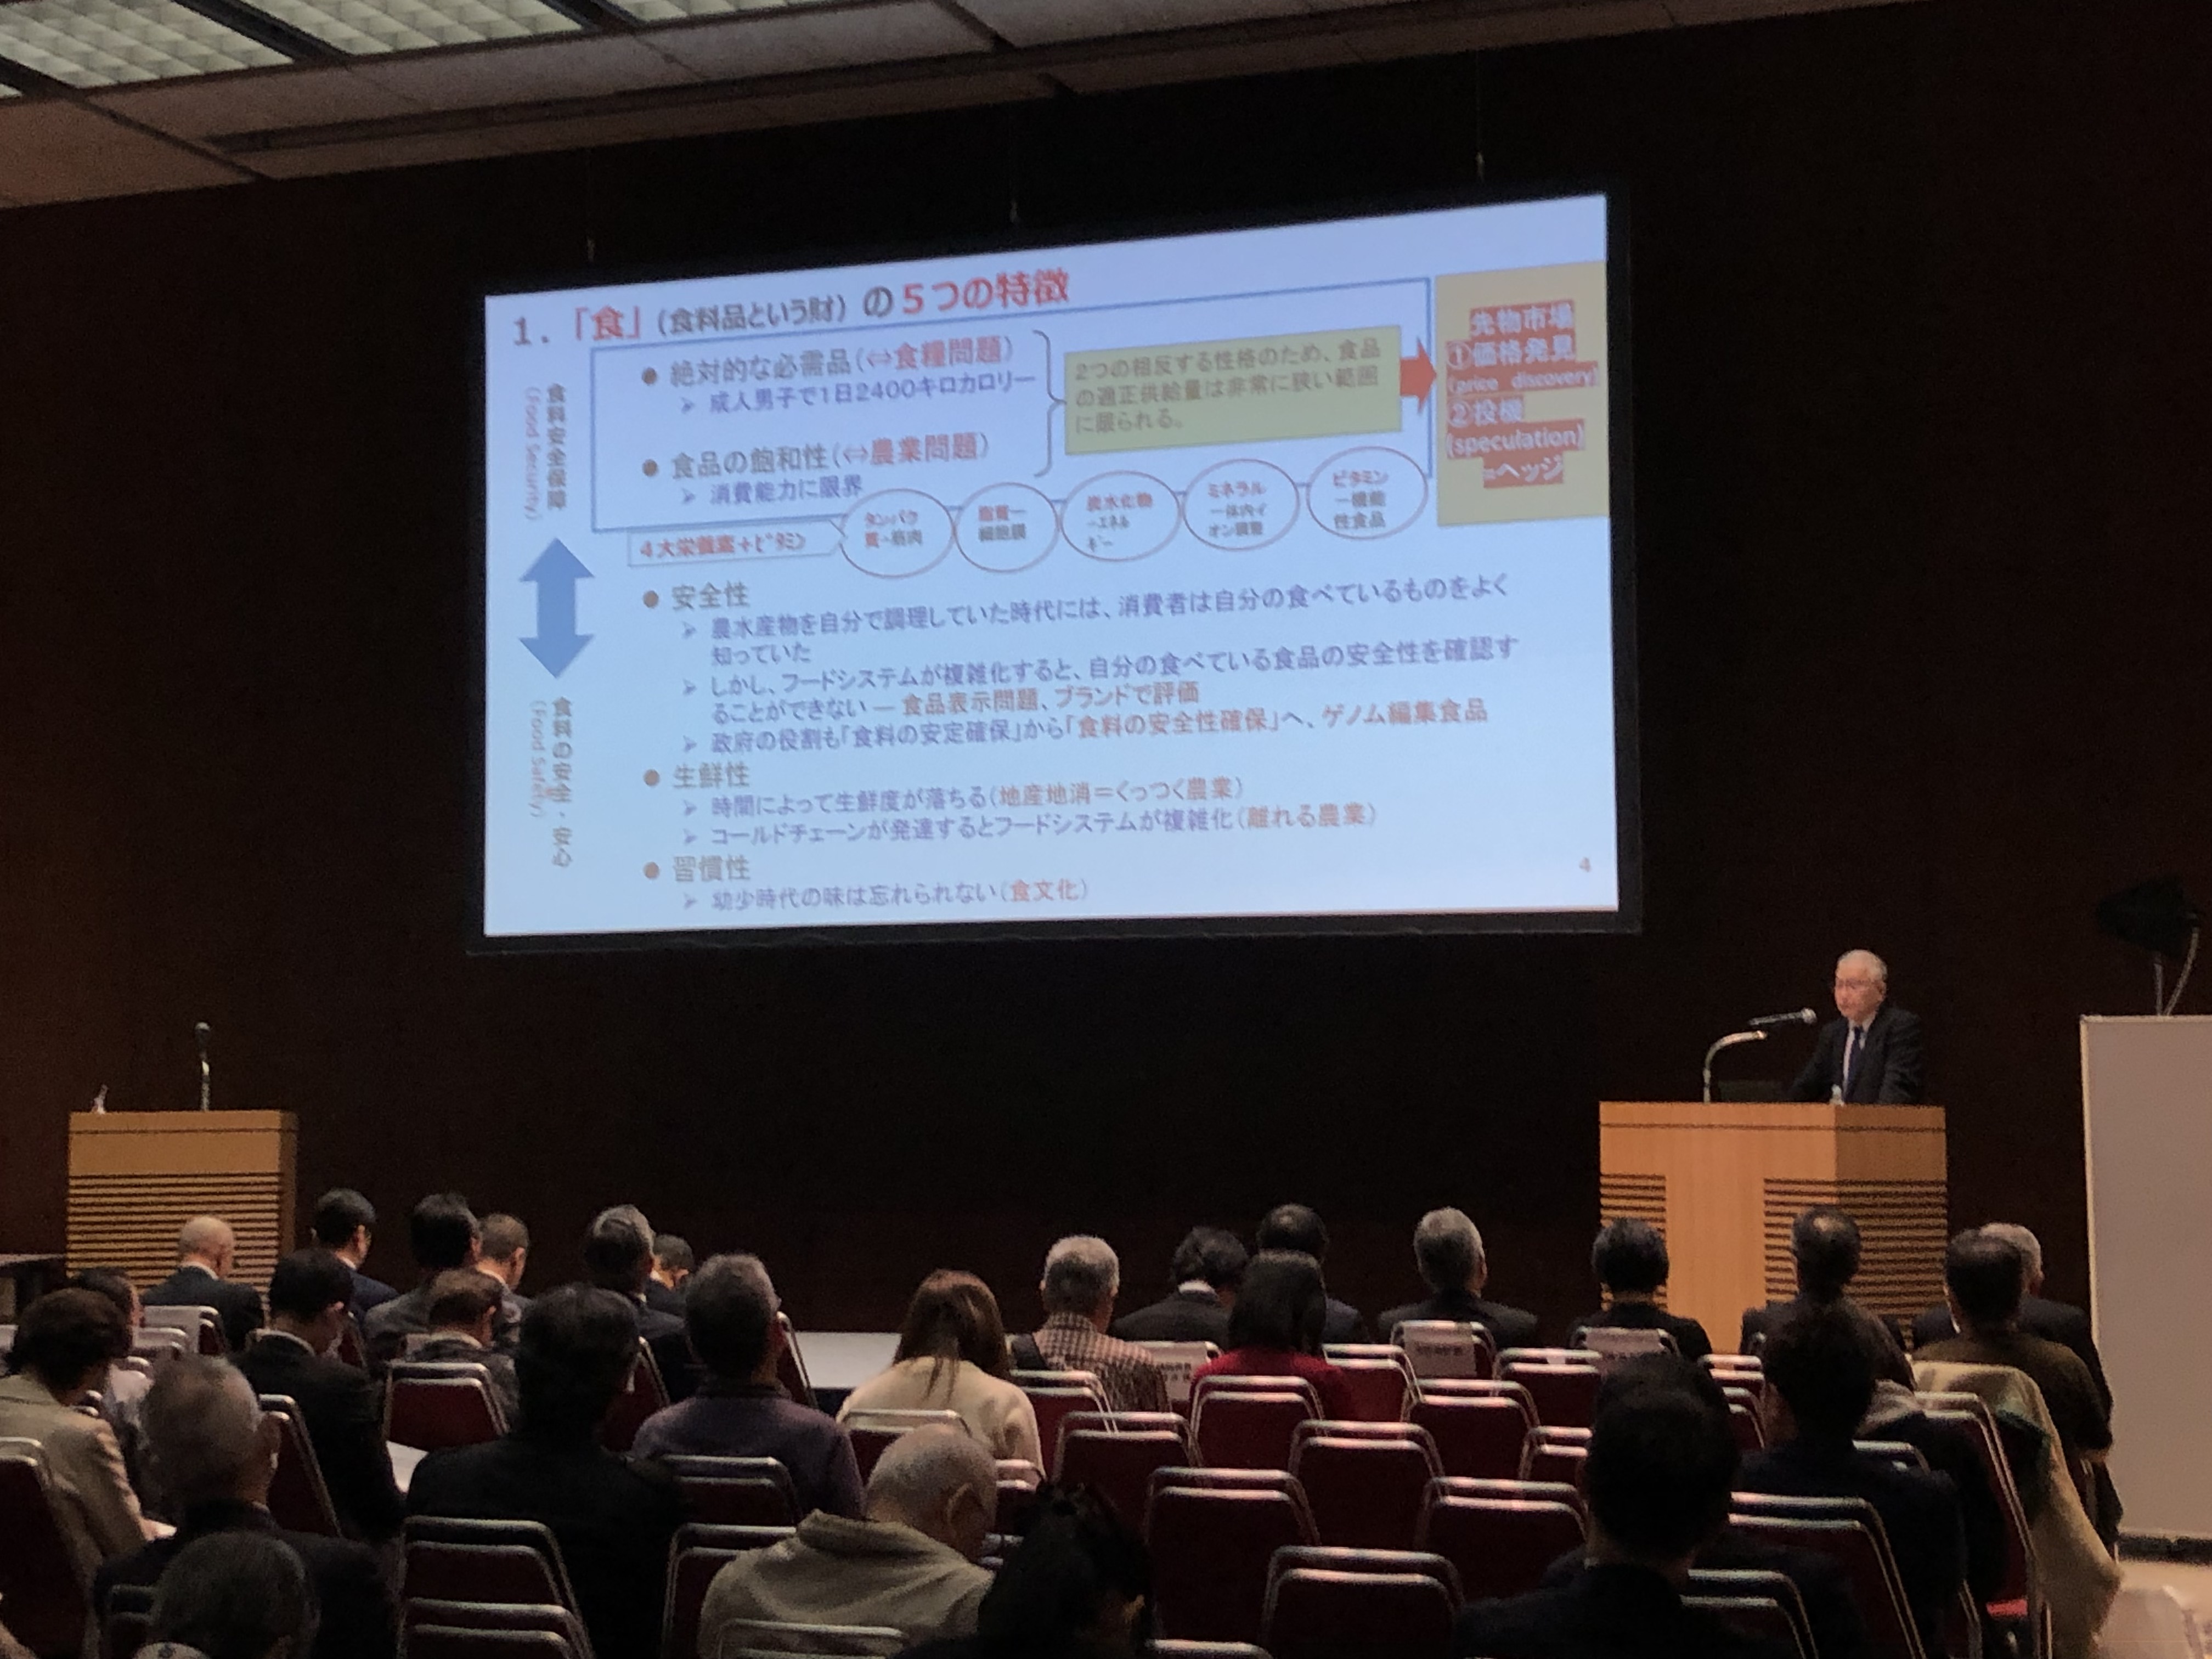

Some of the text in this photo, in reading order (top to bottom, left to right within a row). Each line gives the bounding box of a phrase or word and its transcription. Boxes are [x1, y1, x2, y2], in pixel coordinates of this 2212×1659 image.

[514, 316, 549, 346] 1.
[710, 370, 1036, 413] 成人男子で1日2400キロカロリー
[710, 473, 863, 505] 消費能力に限界
[672, 580, 749, 610] 安全性
[712, 641, 811, 665] 知っていた
[673, 760, 750, 789] 生鮮性
[673, 854, 750, 882] 習慣性
[1579, 857, 1592, 873] 4
